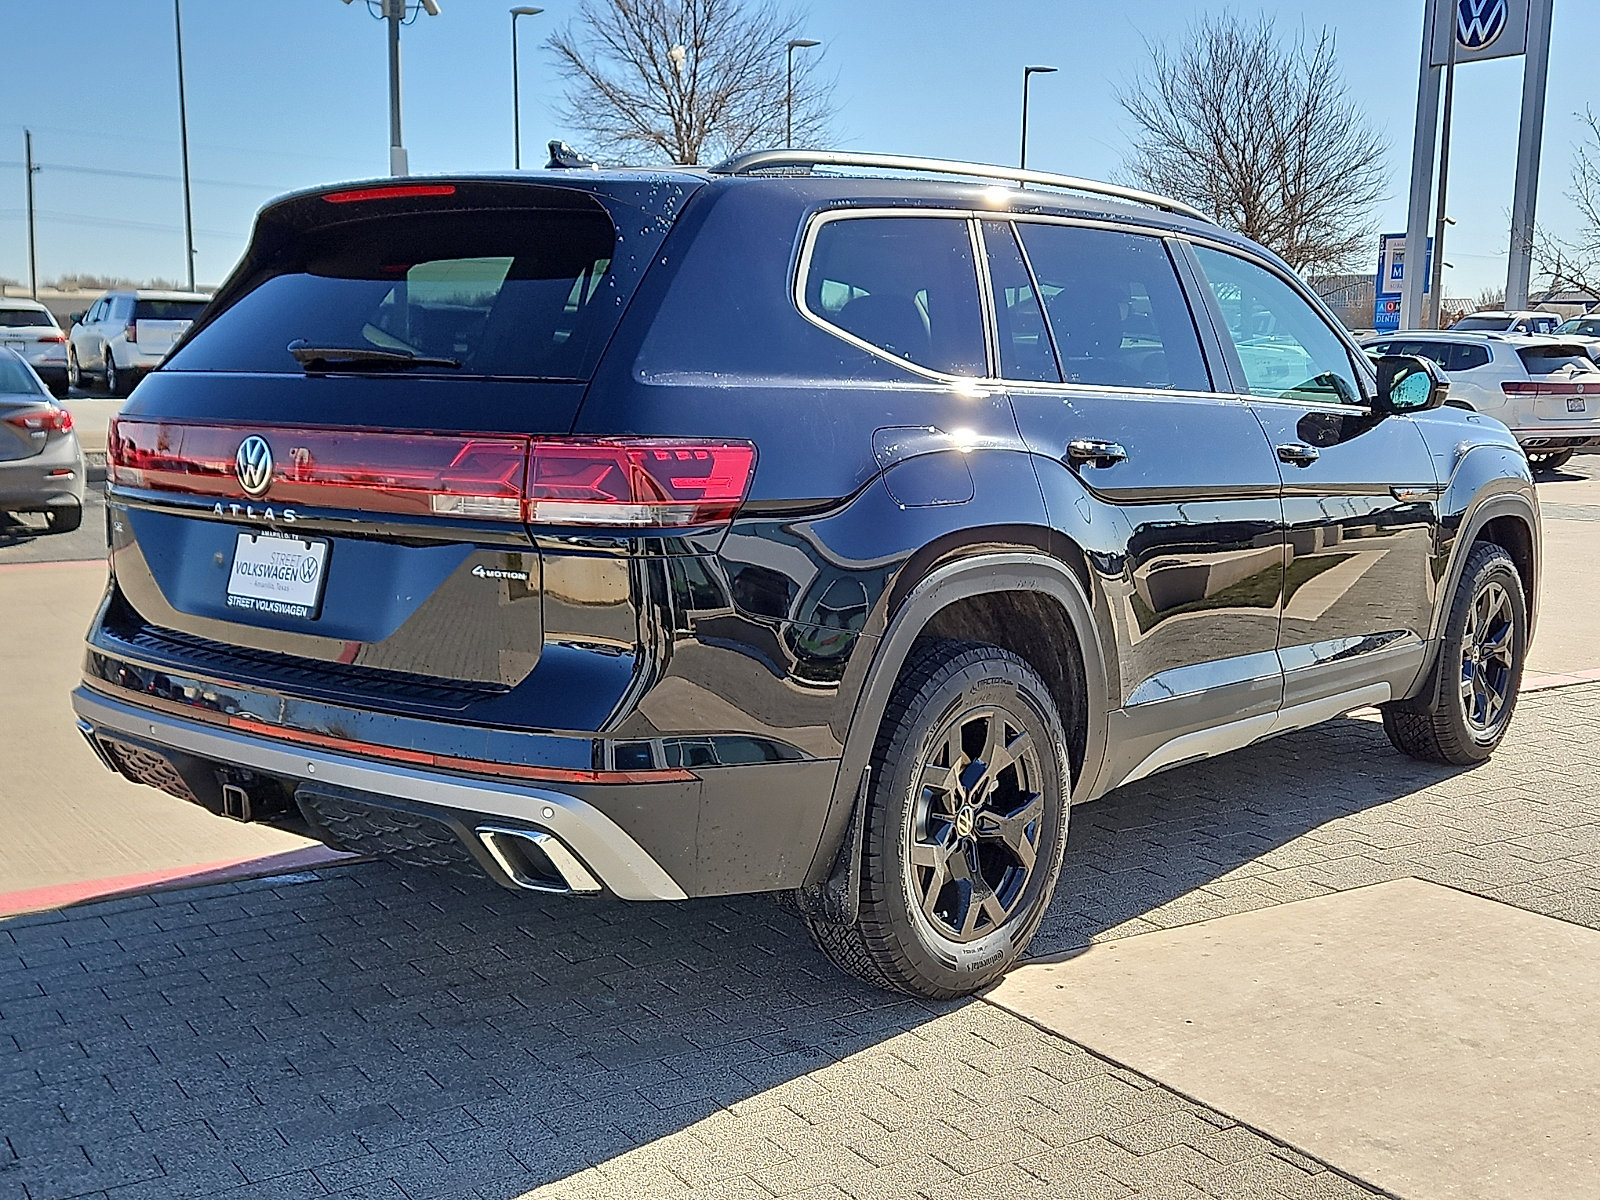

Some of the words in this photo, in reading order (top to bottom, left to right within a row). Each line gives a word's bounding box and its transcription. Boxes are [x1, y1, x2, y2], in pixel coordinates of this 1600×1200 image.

[213, 502, 297, 523] ATLAS
[270, 552, 302, 568] STREET
[236, 561, 299, 582] VOLKSWAGEN
[471, 565, 528, 580] 4MOTION
[227, 595, 257, 609] STREET
[255, 600, 308, 617] VOLKSWAGEN
